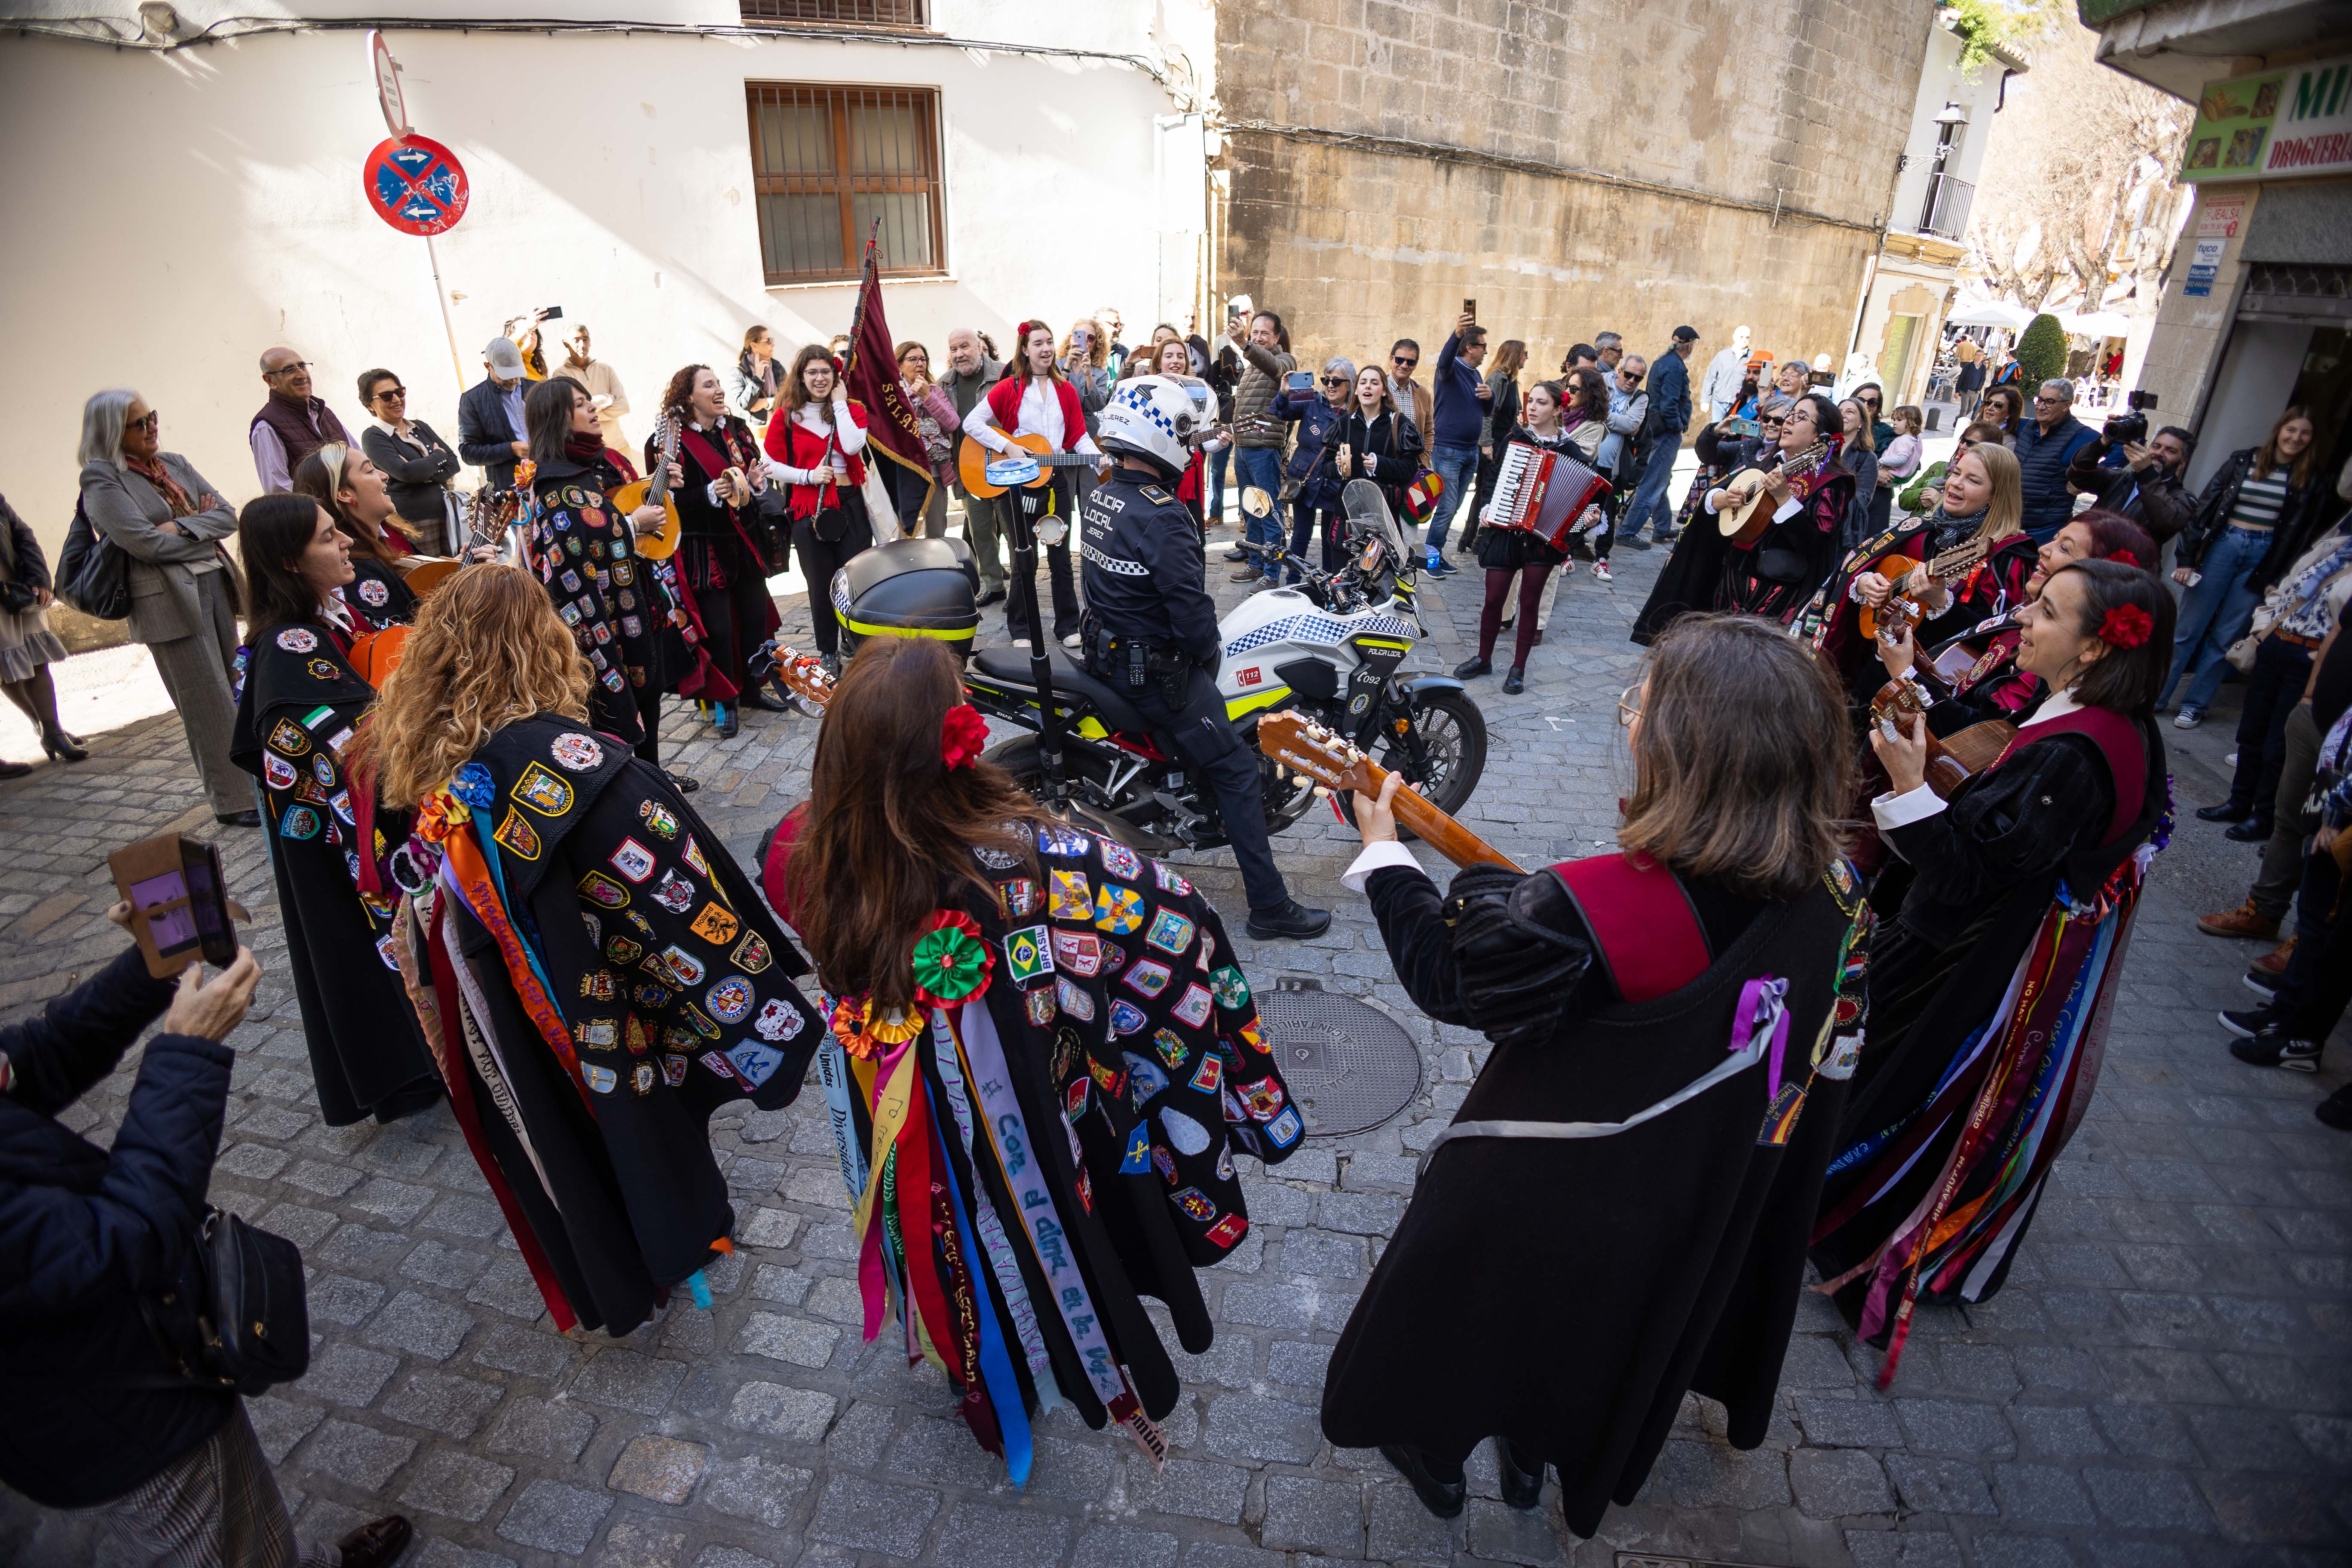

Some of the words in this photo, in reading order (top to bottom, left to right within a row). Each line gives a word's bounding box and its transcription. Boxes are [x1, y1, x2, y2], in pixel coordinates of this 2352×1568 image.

[2288, 64, 2352, 122] MI
[2211, 208, 2241, 220] JEALSA
[2197, 244, 2218, 254] tyco
[1108, 414, 1130, 426] JEREZ
[1089, 490, 1126, 513] POLICIA
[1084, 506, 1113, 531] LOCAL
[1087, 526, 1104, 540] JEREZ
[1368, 648, 1387, 656] POLICIA
[1246, 671, 1259, 679] 112
[1363, 675, 1380, 684] 092
[996, 711, 1013, 720] SHAD
[549, 787, 571, 814] SALAMANCA
[637, 861, 649, 876] ZAMORA
[694, 906, 714, 928] Holland
[734, 934, 755, 962] AMSTERDAM
[1037, 928, 1051, 969] BRASIL
[690, 971, 704, 985] SEVILLA
[2024, 980, 2035, 997] NO
[714, 1003, 743, 1018] ALFONSO
[2015, 999, 2027, 1022] HAY
[819, 1054, 833, 1088] Unidas
[1320, 1068, 1359, 1093] AGUAS
[1298, 1084, 1317, 1095] DE
[1767, 1086, 1794, 1118] NACIONAL
[1774, 1112, 1782, 1121] DE
[830, 1106, 851, 1185] Diversidad
[1207, 1213, 1233, 1235] CUENCA
[1035, 1216, 1068, 1276] alma
[1061, 1286, 1084, 1312] en
